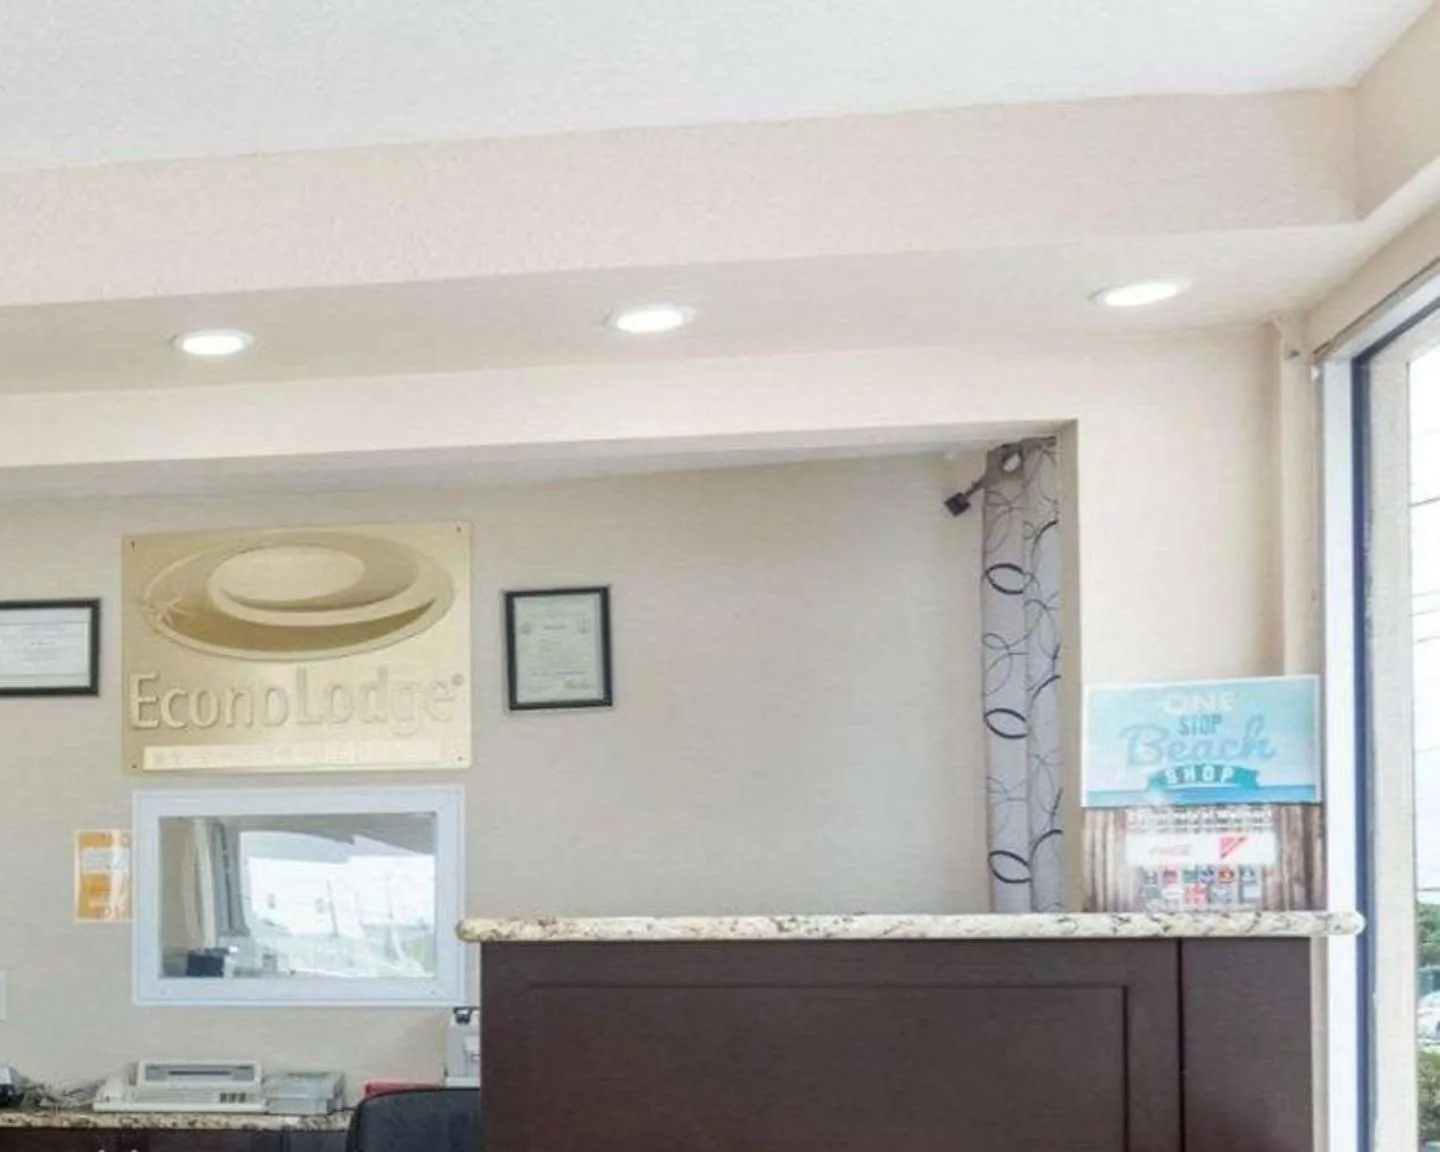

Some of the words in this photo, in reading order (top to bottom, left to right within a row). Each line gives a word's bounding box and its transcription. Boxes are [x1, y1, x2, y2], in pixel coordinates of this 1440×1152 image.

[129, 666, 454, 736] EconoLodge
[1117, 713, 1278, 766] Beach
[1165, 766, 1235, 784] SHOP
